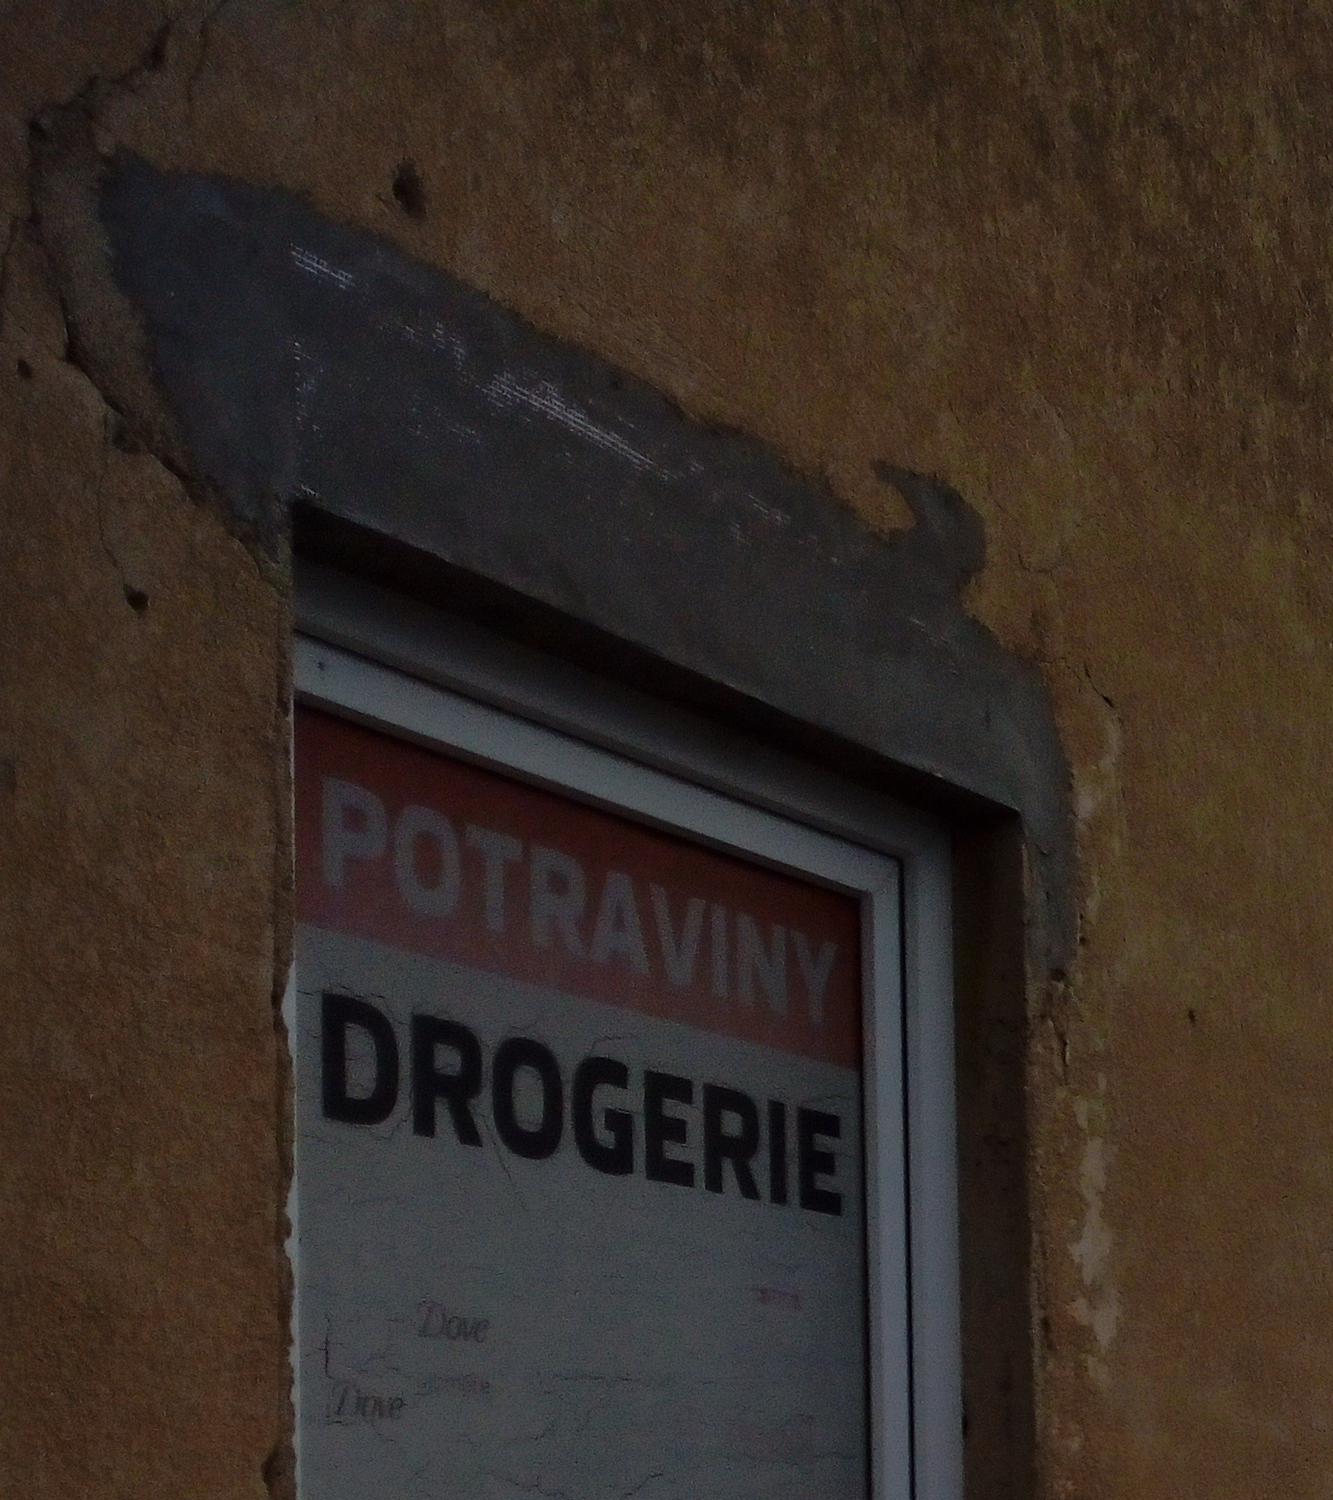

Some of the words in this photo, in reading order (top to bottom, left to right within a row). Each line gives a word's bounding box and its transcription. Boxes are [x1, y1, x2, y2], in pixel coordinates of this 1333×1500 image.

[321, 775, 841, 1025] POTRAVINY
[321, 991, 843, 1217] DROGERIE
[417, 1297, 491, 1344] Dove
